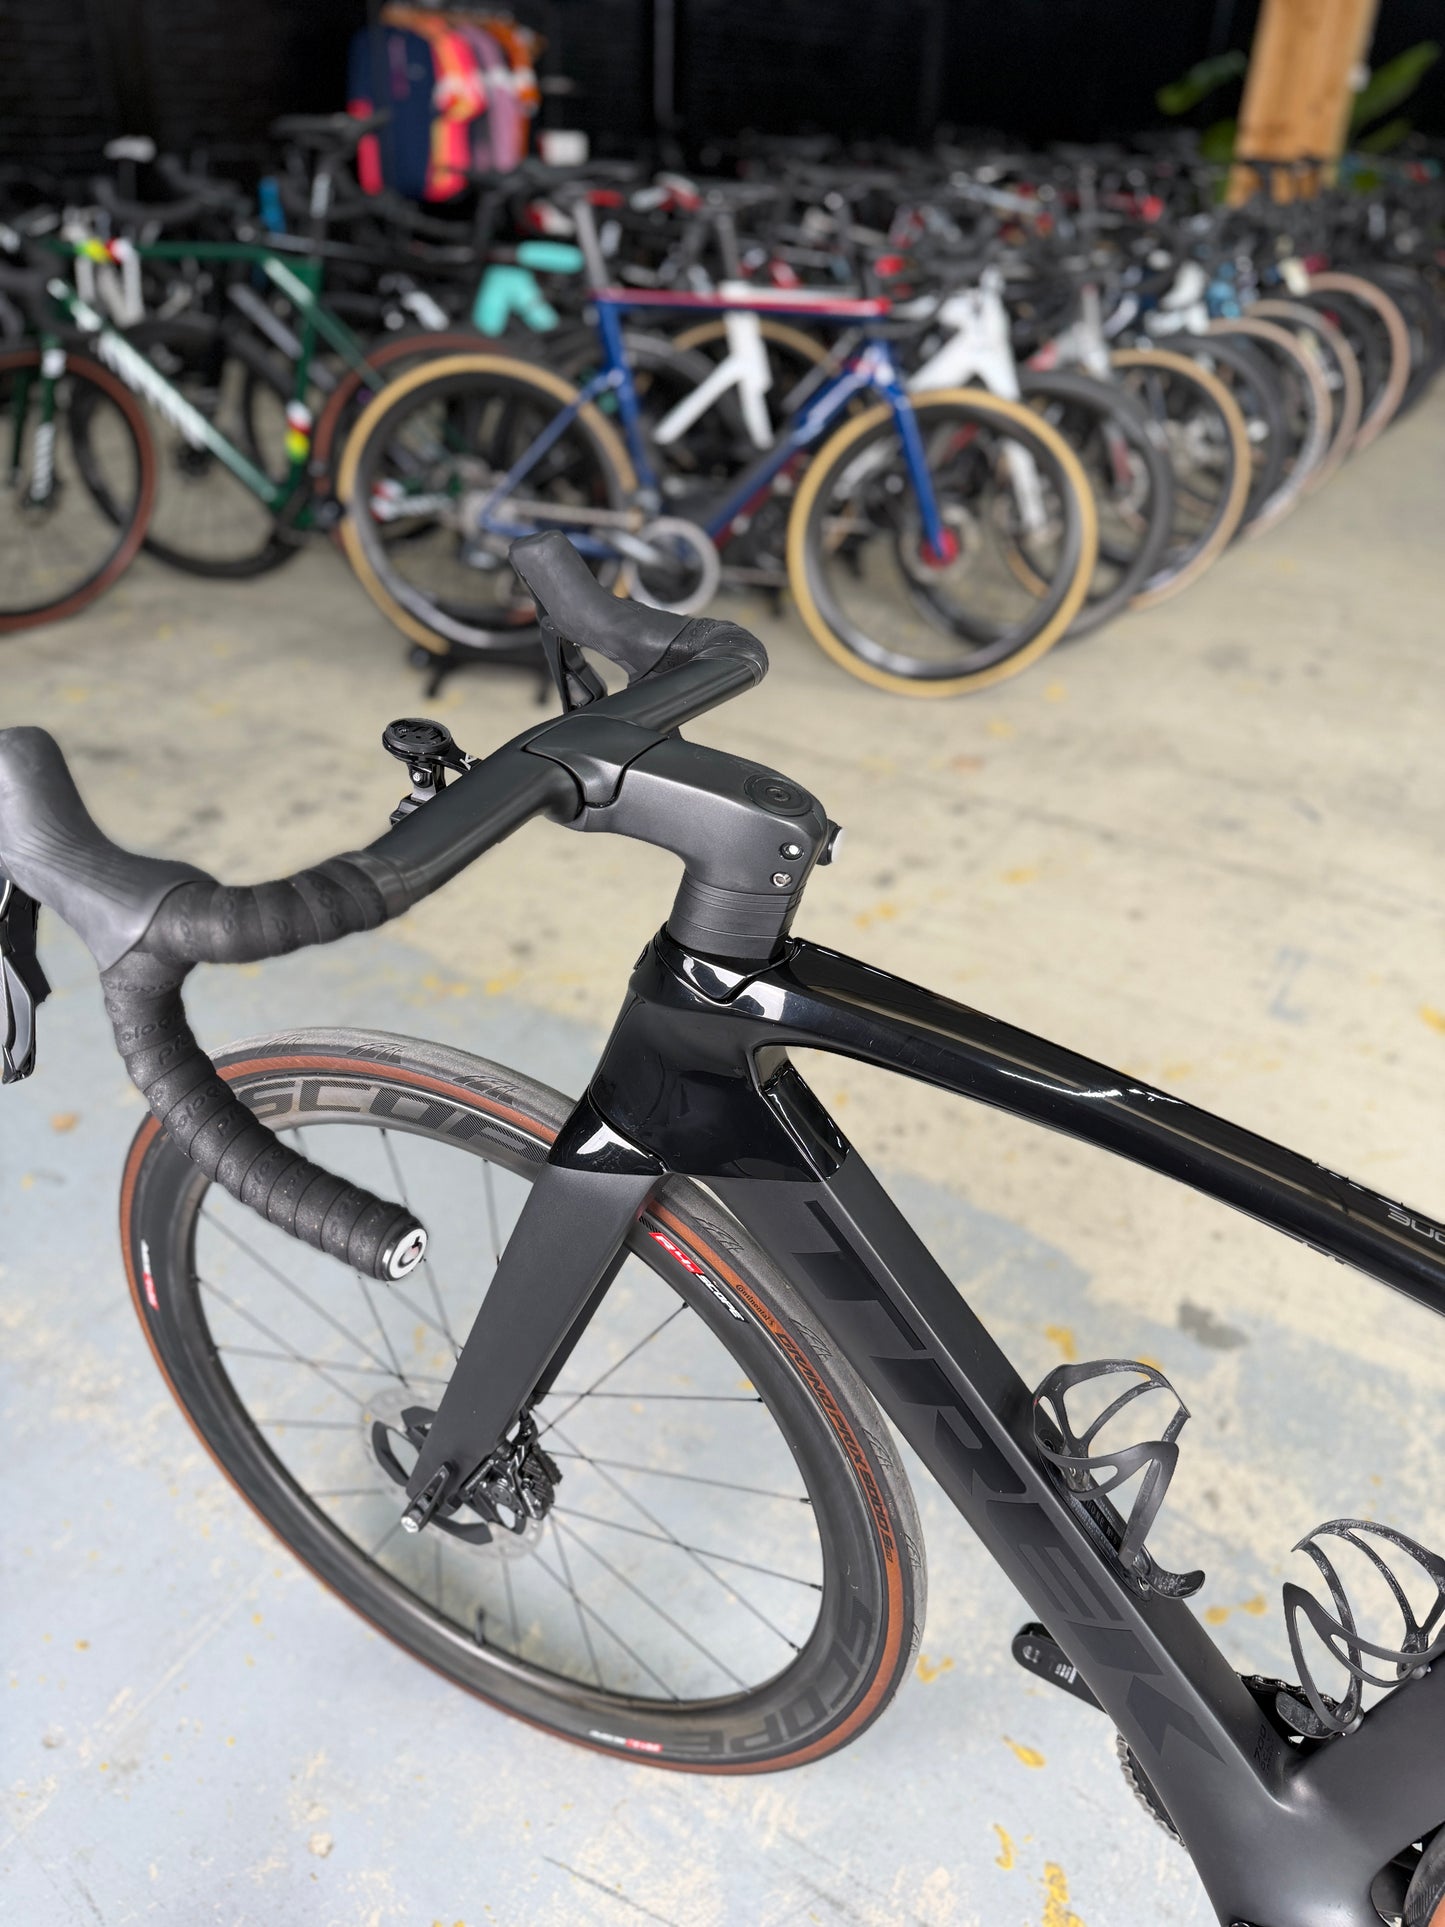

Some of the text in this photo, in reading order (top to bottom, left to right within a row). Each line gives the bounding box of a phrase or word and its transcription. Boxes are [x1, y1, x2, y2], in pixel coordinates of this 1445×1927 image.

[695, 1273, 745, 1321] SCOPE
[736, 1284, 769, 1321] Continental
[775, 1332, 836, 1411] GRAND
[830, 1410, 867, 1470] PRIX
[791, 1200, 1229, 1767] TREK
[672, 1596, 873, 1755] SCOPE
